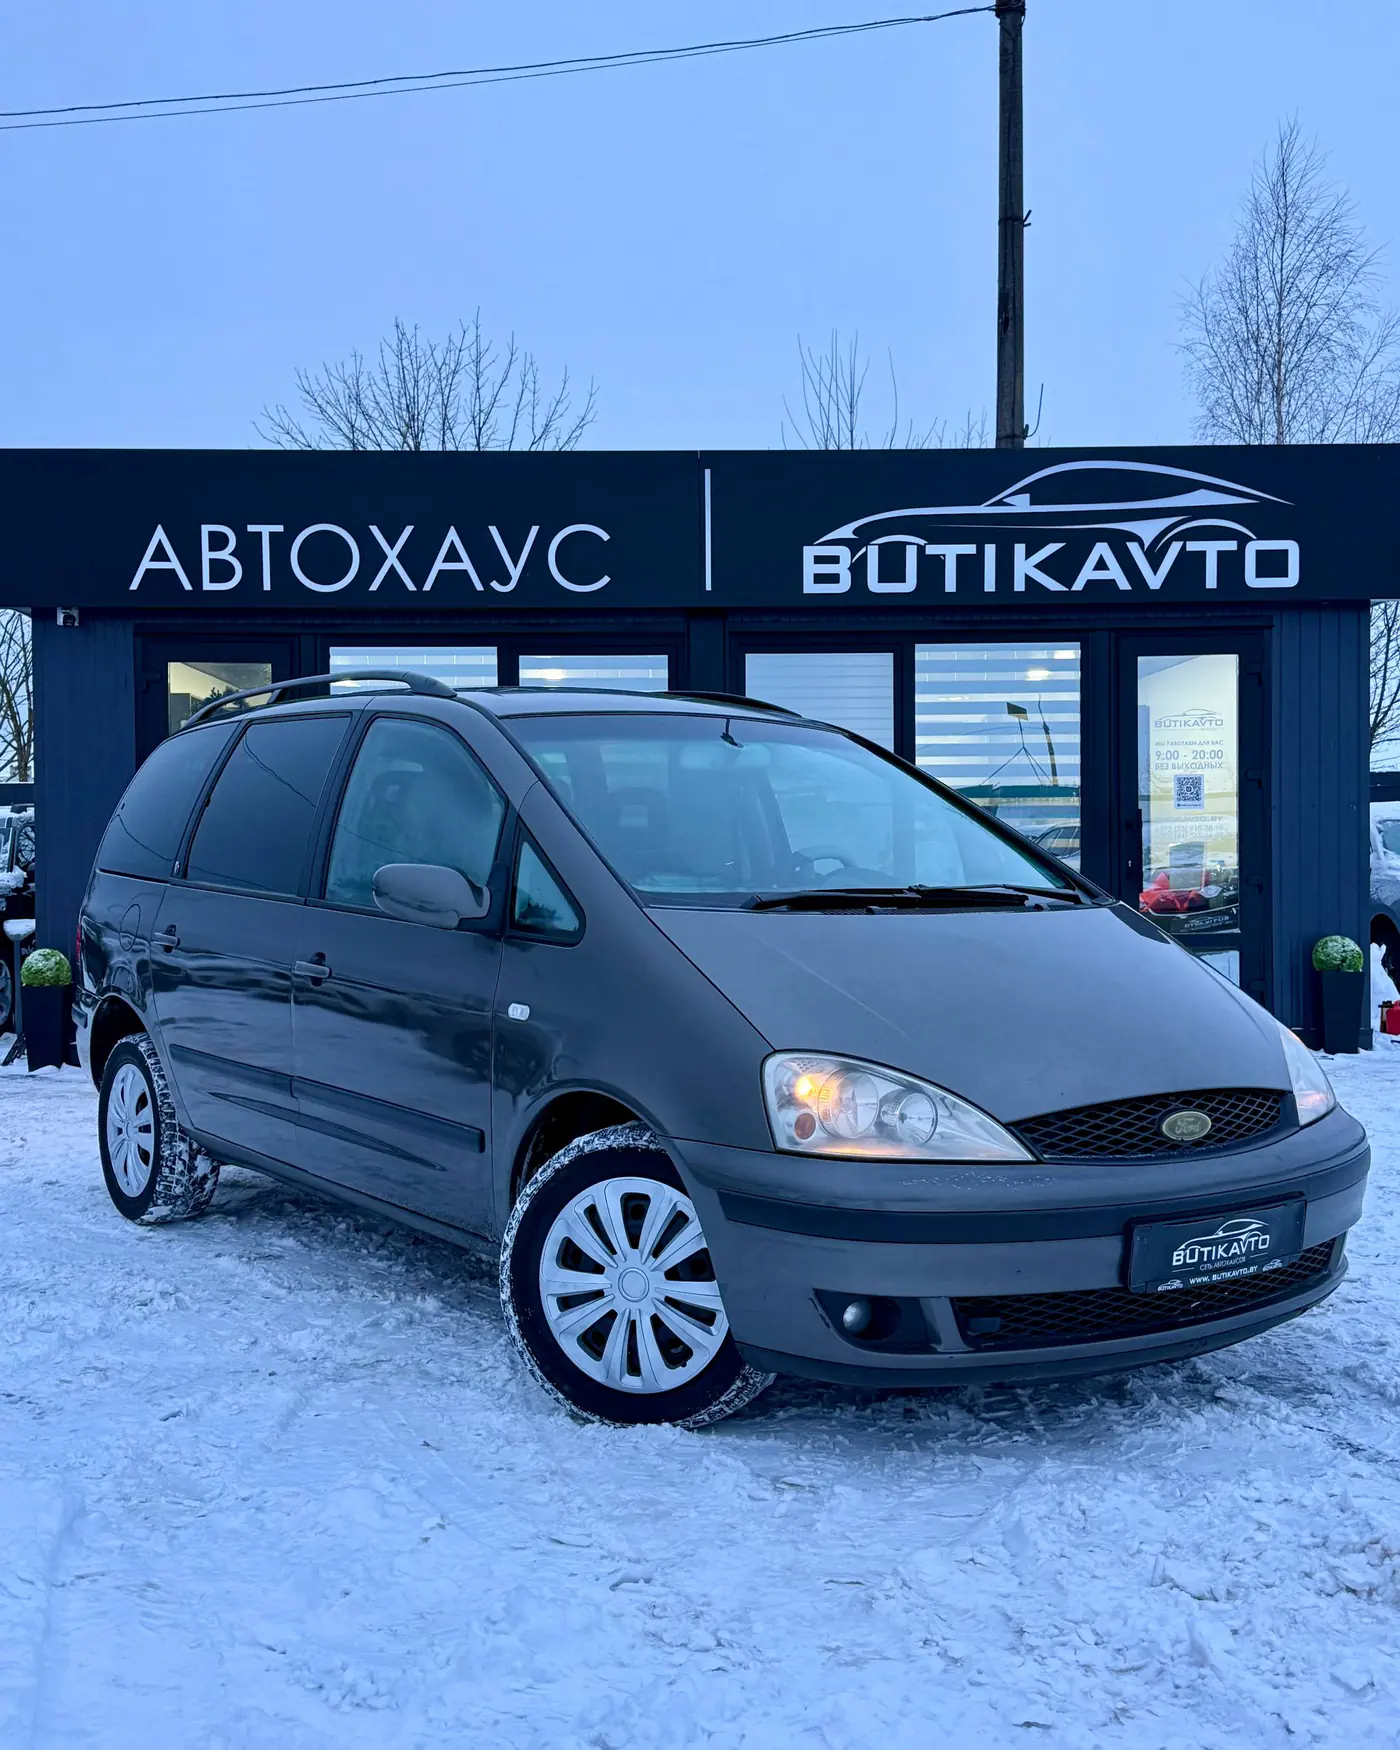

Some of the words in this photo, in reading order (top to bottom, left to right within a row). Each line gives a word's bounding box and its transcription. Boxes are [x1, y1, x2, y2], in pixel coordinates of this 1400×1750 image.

[129, 523, 611, 592] АВТОХАУС
[802, 538, 1300, 594] BUTIKAVTO
[1154, 719, 1223, 728] BUTIKAVTO
[1155, 750, 1180, 760] 9:00
[1191, 749, 1224, 760] 20:00
[1155, 762, 1169, 770] БЕЗ
[1171, 761, 1224, 770] ВЫХОДНЫХ
[1172, 1235, 1270, 1266] BUTIKAVTO
